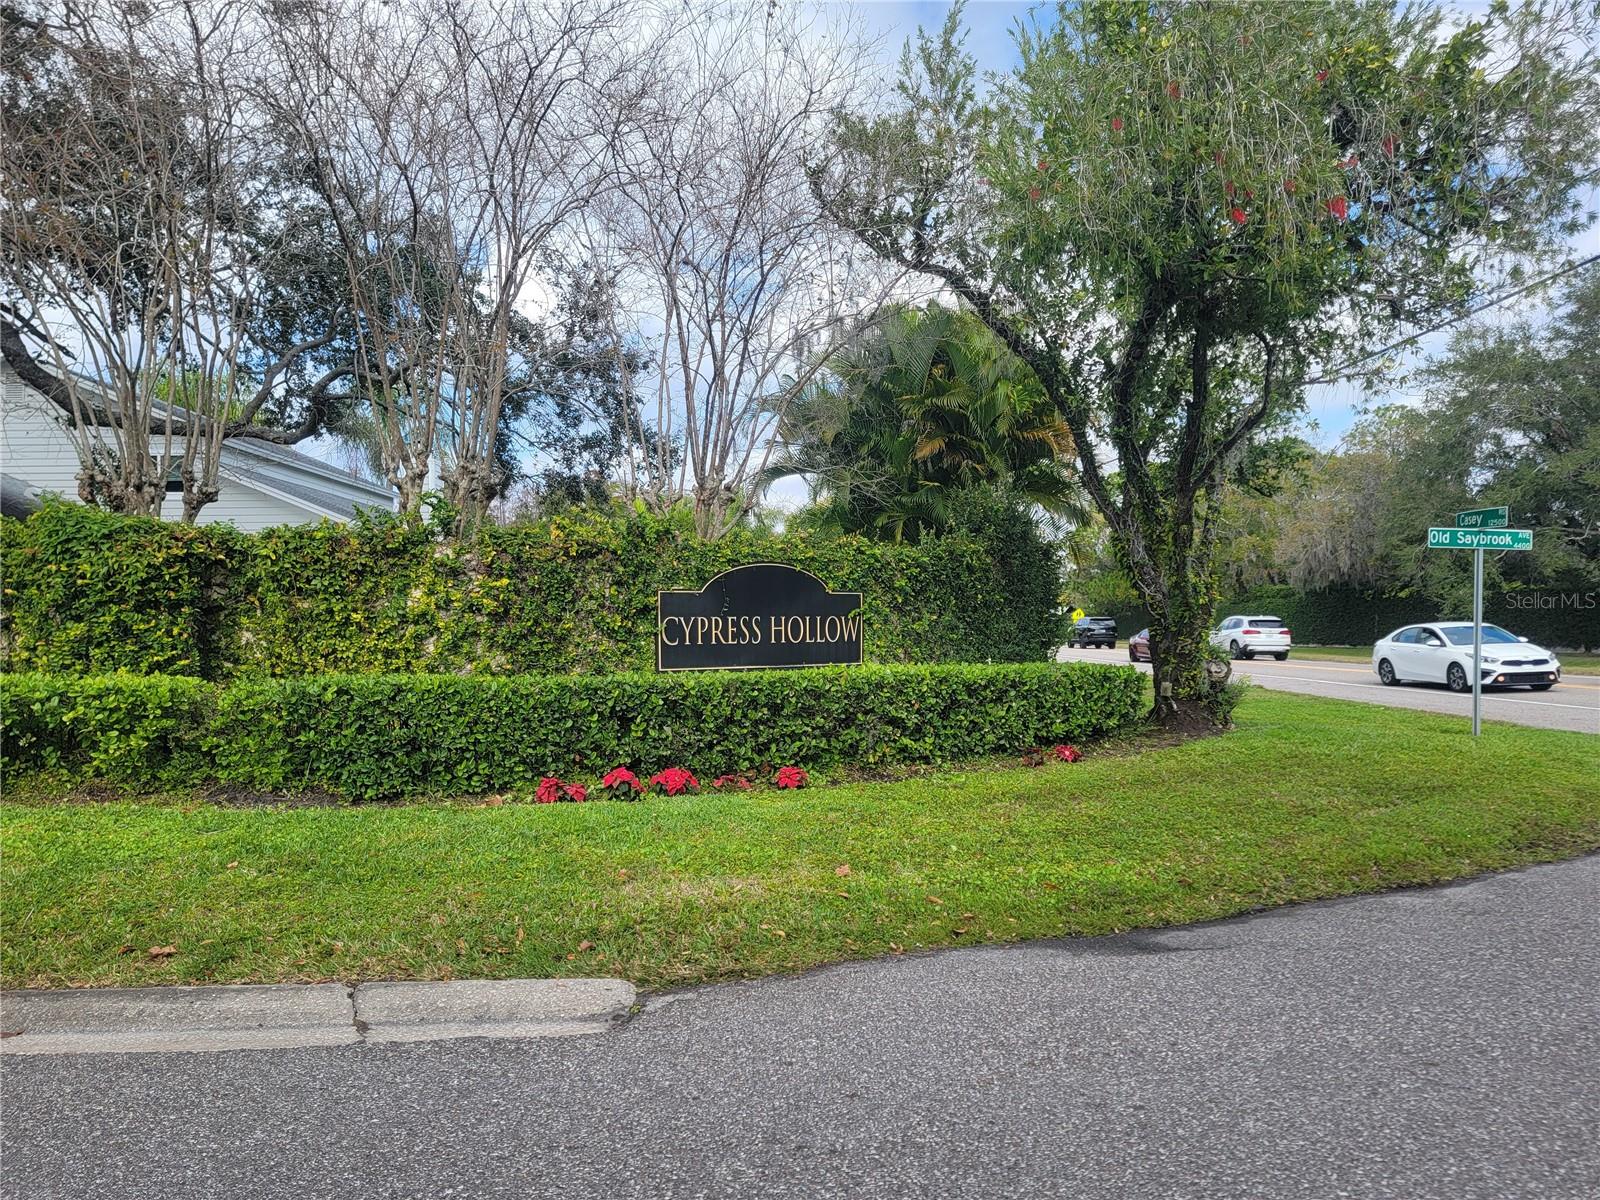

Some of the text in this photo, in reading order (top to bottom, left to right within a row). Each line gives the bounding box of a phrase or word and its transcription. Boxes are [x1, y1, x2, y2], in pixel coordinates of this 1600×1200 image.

[1460, 514, 1483, 527] Casey
[1488, 518, 1506, 526] 12500
[1430, 531, 1450, 543] Old
[1457, 532, 1513, 547] Saybrook
[662, 615, 860, 646] CYPRESS HOLLOW
